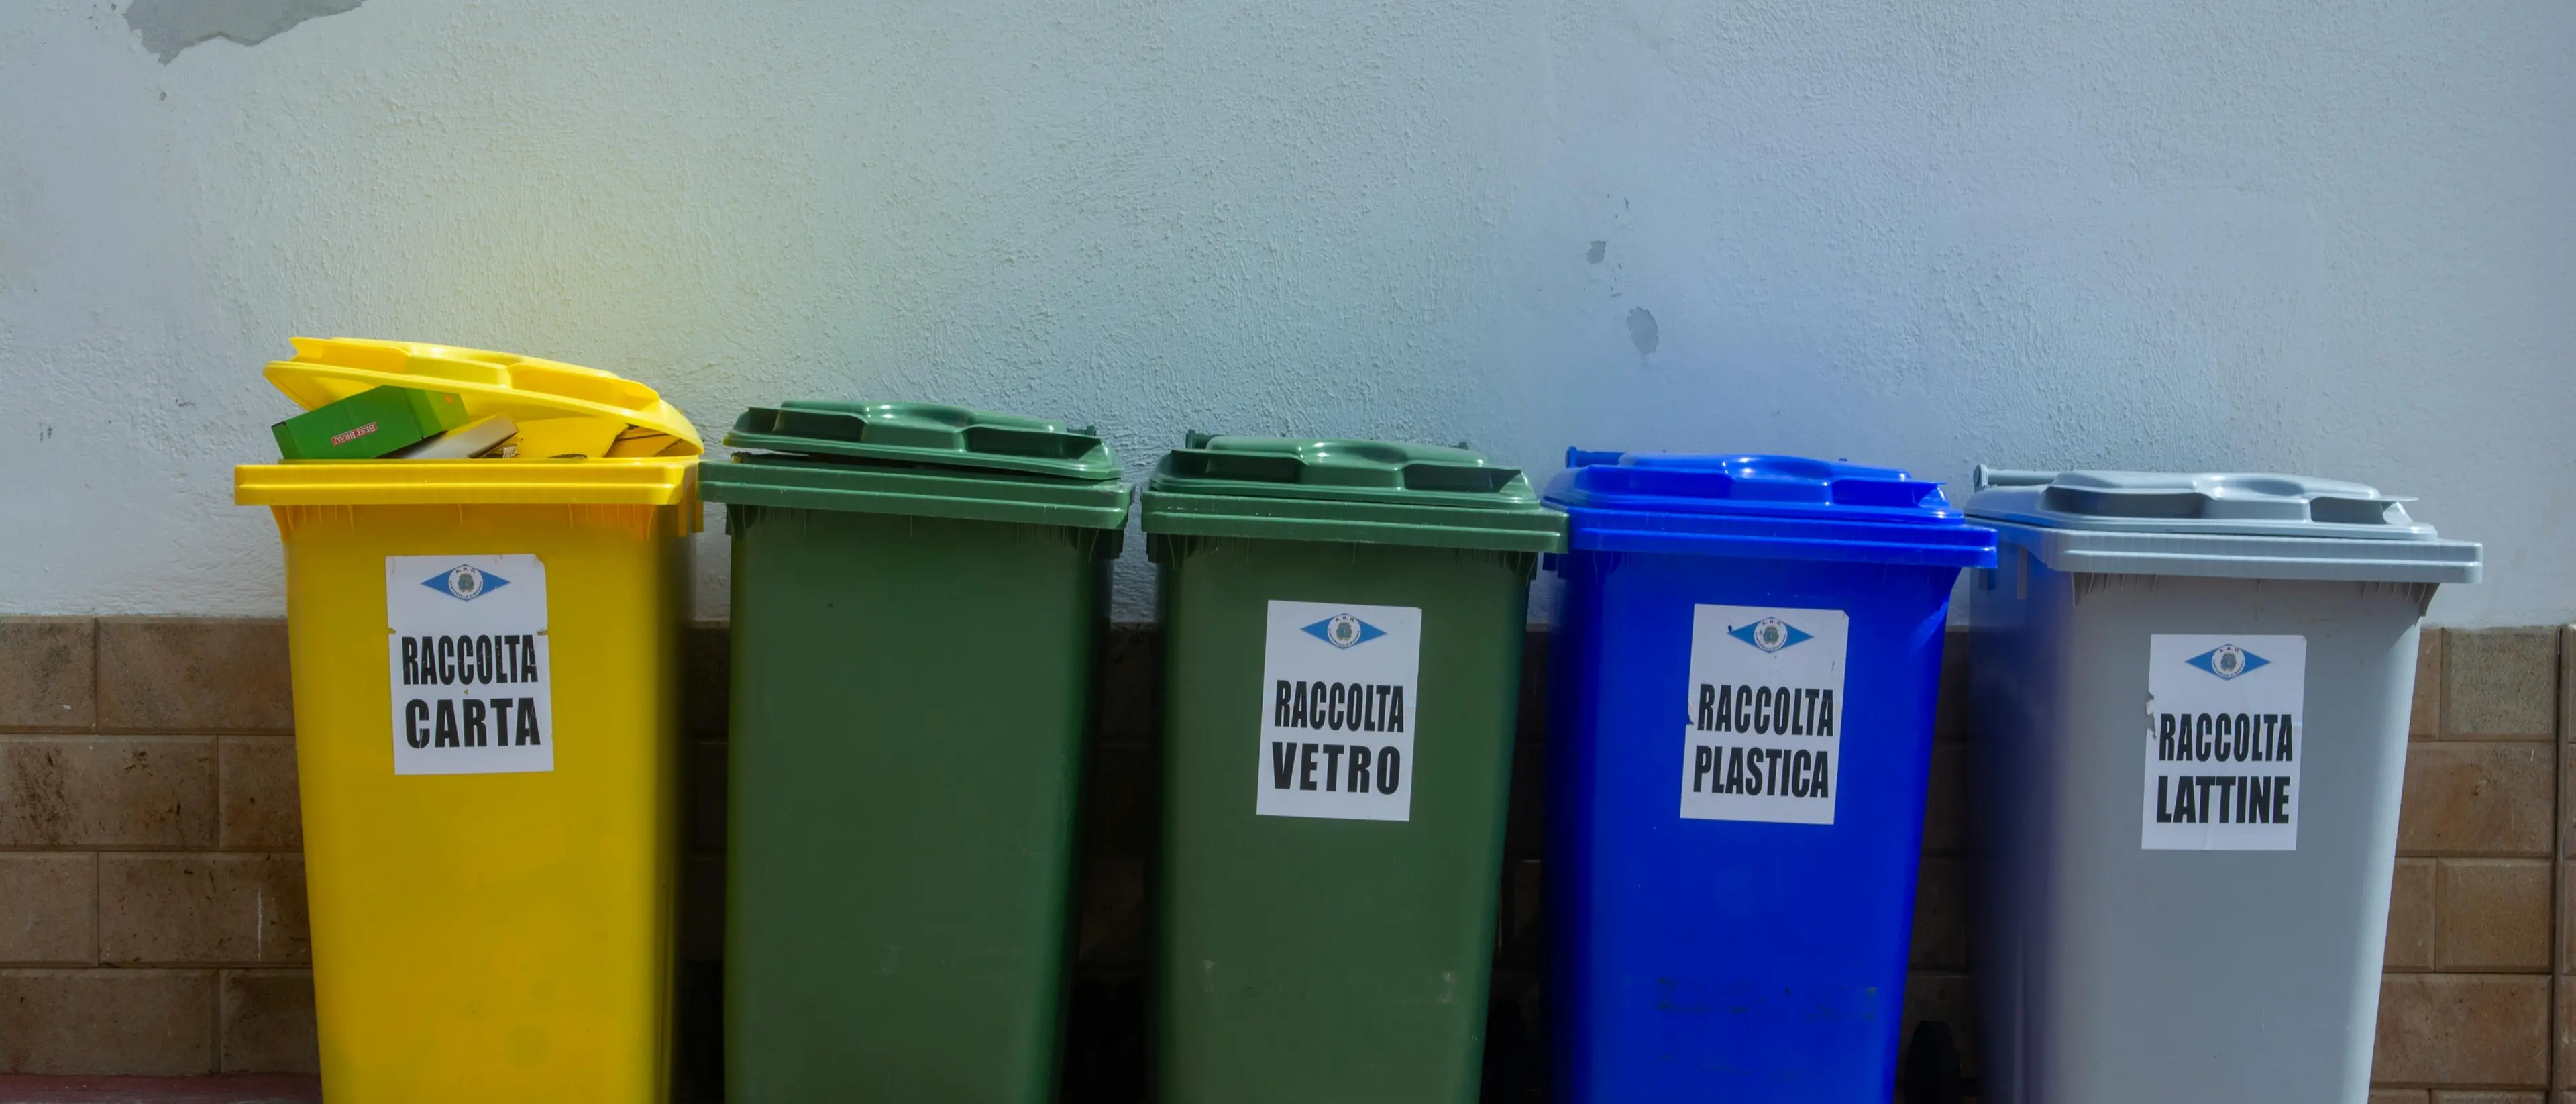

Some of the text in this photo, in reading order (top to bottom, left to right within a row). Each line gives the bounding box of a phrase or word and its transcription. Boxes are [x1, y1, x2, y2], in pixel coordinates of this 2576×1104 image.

[357, 424, 376, 436] BEST
[402, 634, 539, 685] RACCOLTA
[405, 697, 541, 749] CARTA
[1274, 679, 1404, 733] RACCOLTA
[1697, 683, 1833, 736] RACCOLTA
[2159, 713, 2293, 762] RACCOLTA
[1272, 741, 1401, 795] VETRO
[1693, 745, 1829, 798] PLASTICA
[2156, 775, 2290, 824] LATTINE
